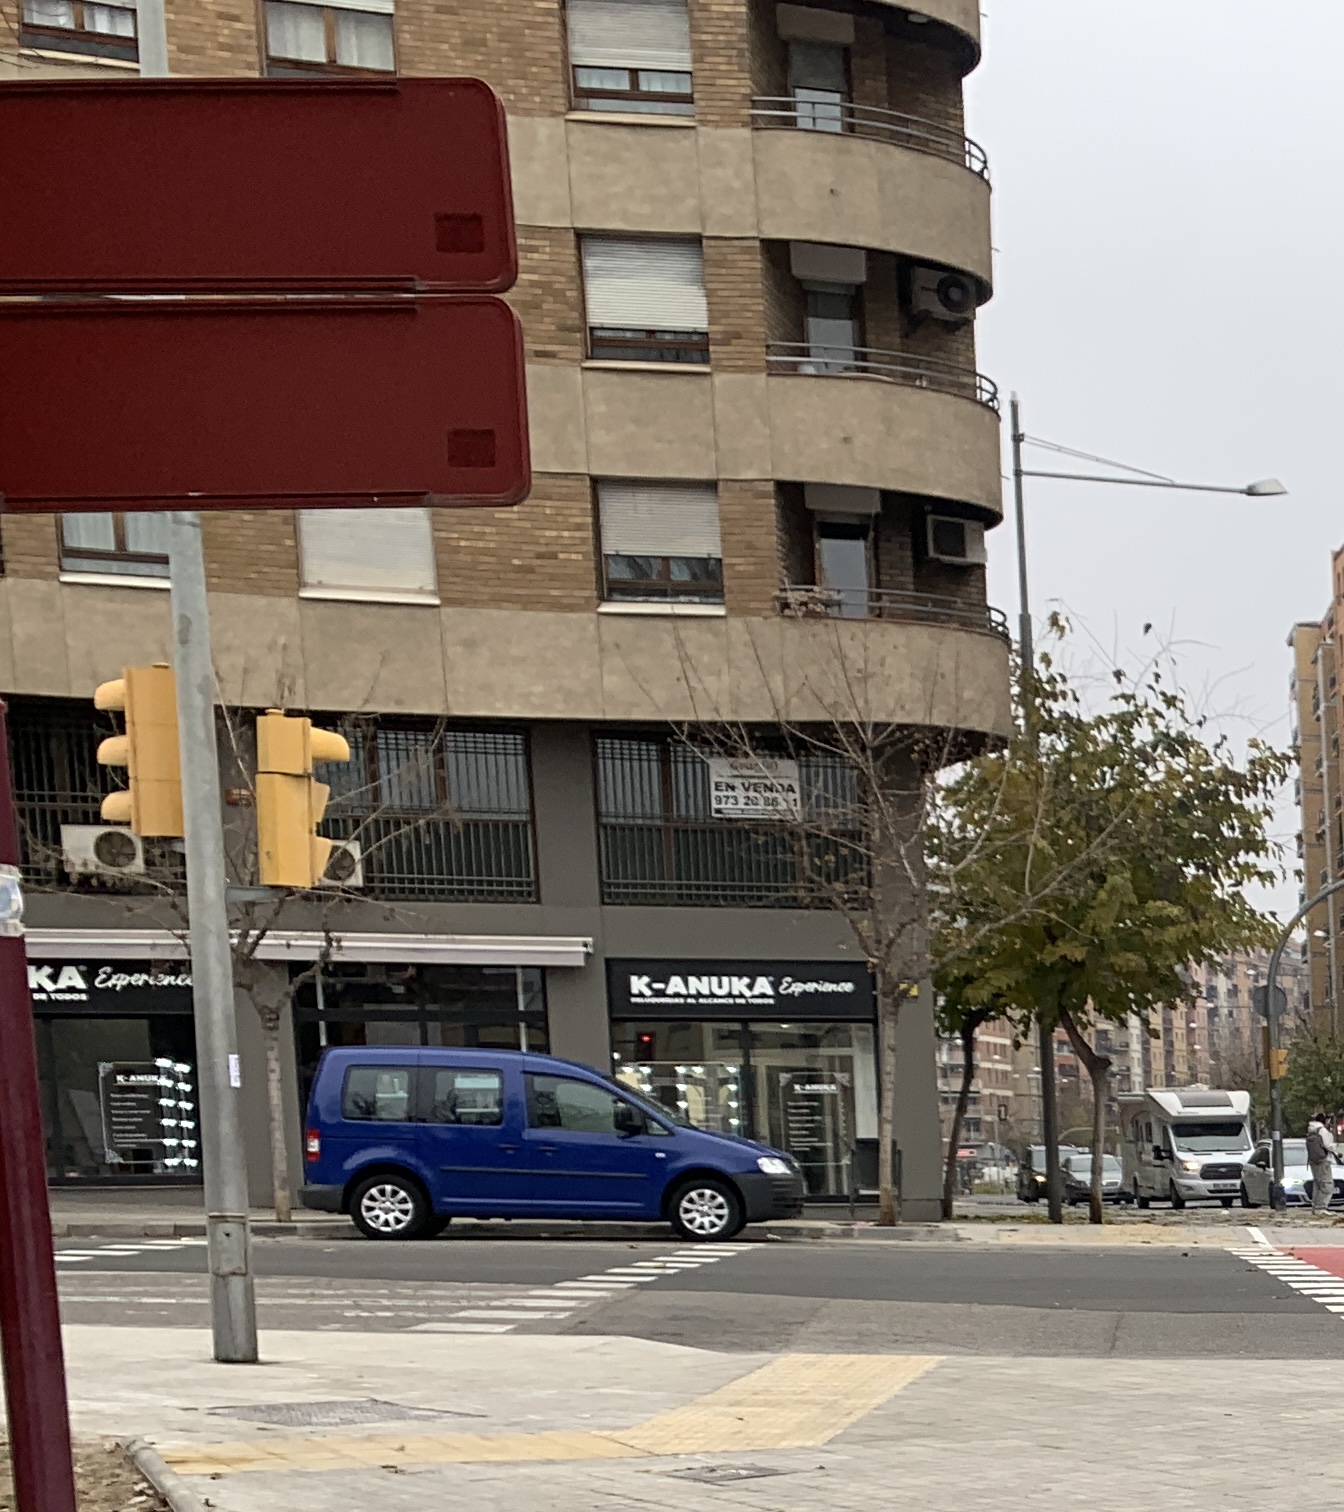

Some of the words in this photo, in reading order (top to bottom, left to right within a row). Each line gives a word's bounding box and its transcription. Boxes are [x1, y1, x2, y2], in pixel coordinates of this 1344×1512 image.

[714, 781, 736, 792] EN
[741, 781, 796, 794] VENDA
[714, 795, 738, 806] 973
[629, 975, 775, 997] K-ANUKA
[778, 976, 856, 997] Experience
[51, 993, 88, 1001] TODOS
